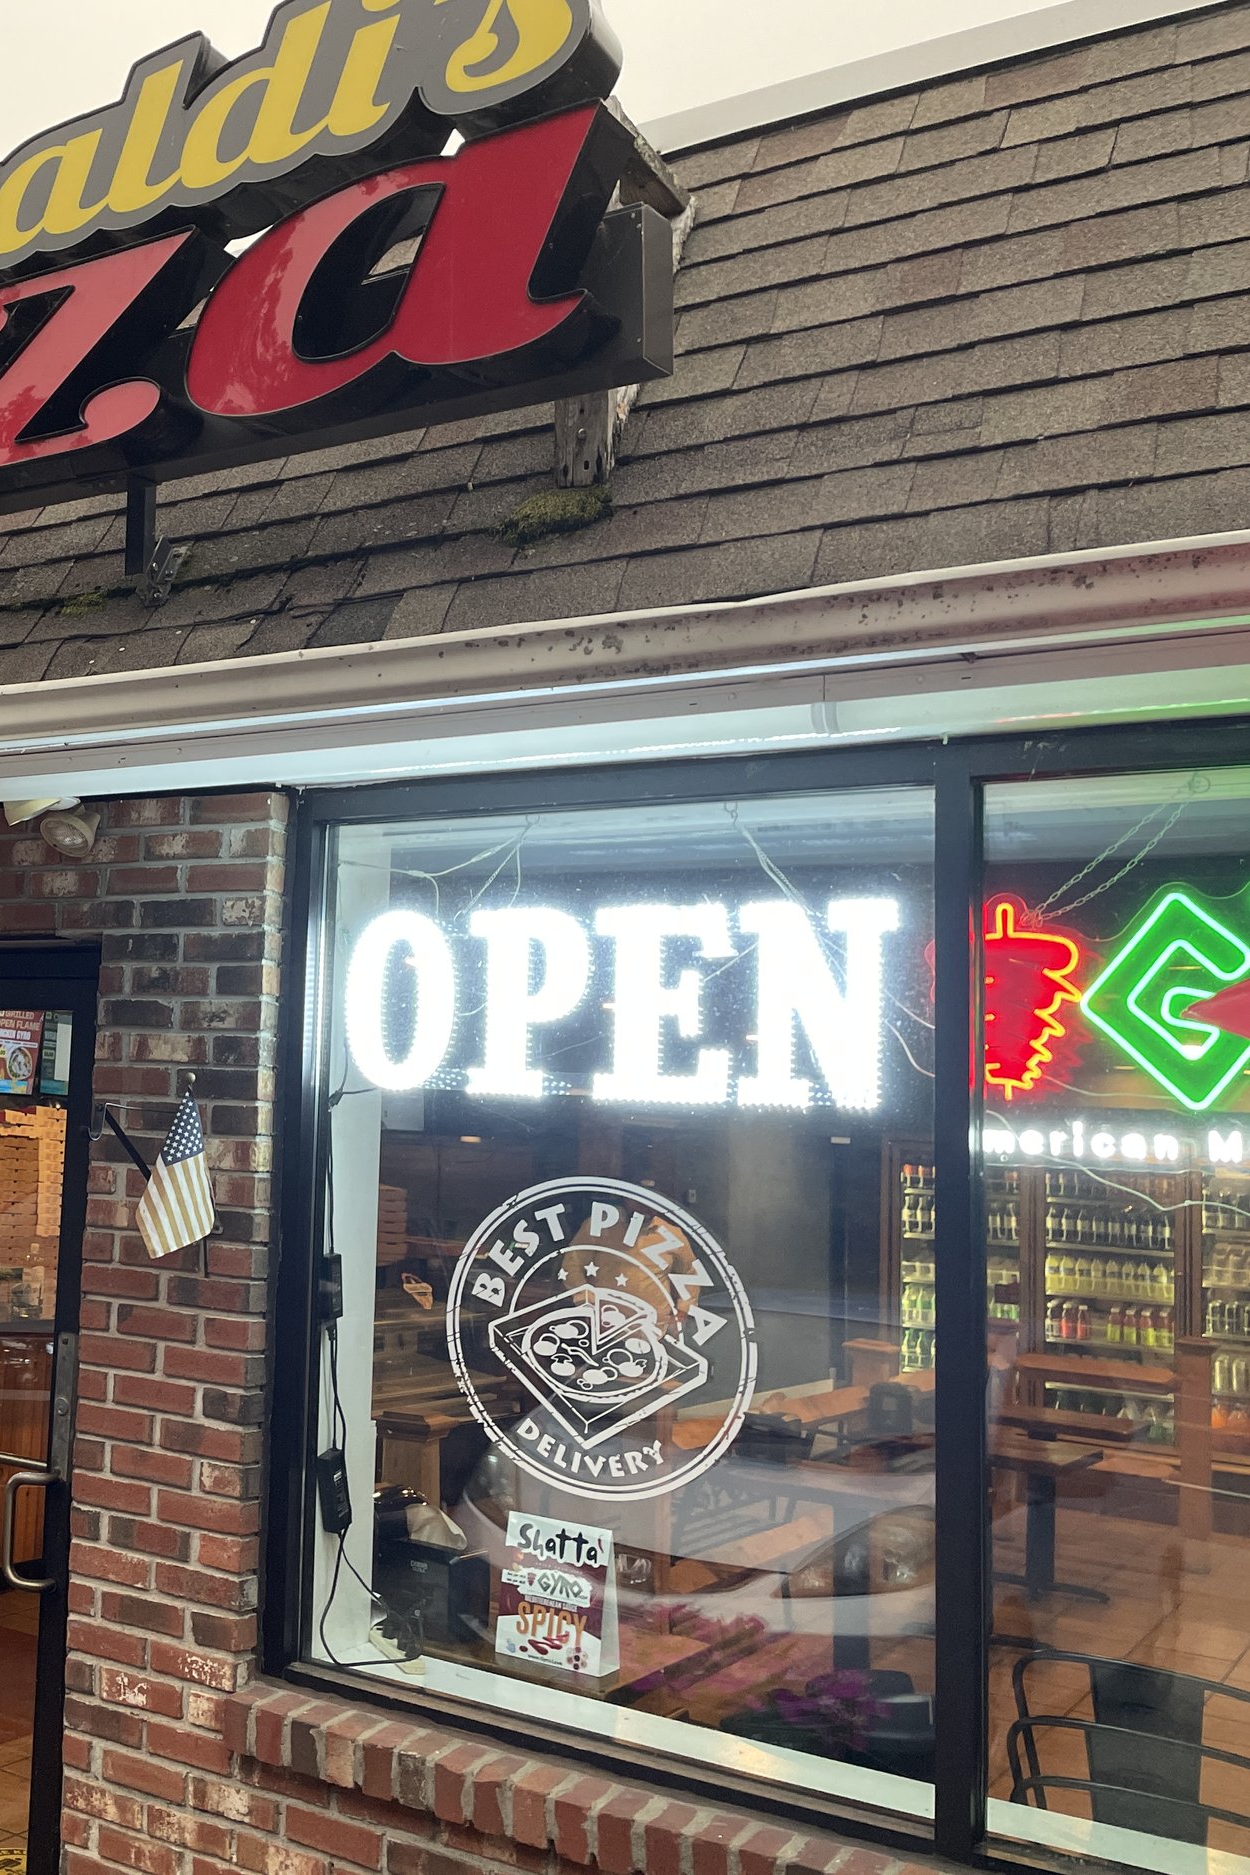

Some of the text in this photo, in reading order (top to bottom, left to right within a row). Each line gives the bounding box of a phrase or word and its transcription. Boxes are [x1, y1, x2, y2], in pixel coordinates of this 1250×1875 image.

[16, 1020, 41, 1031] FLAME
[345, 896, 900, 1113] OPEN
[982, 1120, 1179, 1162] merican
[471, 1201, 728, 1346] BEST PIZZA
[516, 1418, 664, 1479] DELIVERY
[517, 1522, 598, 1564] Shatta
[537, 1572, 583, 1599] GYRO
[516, 1601, 588, 1648] SPICY
